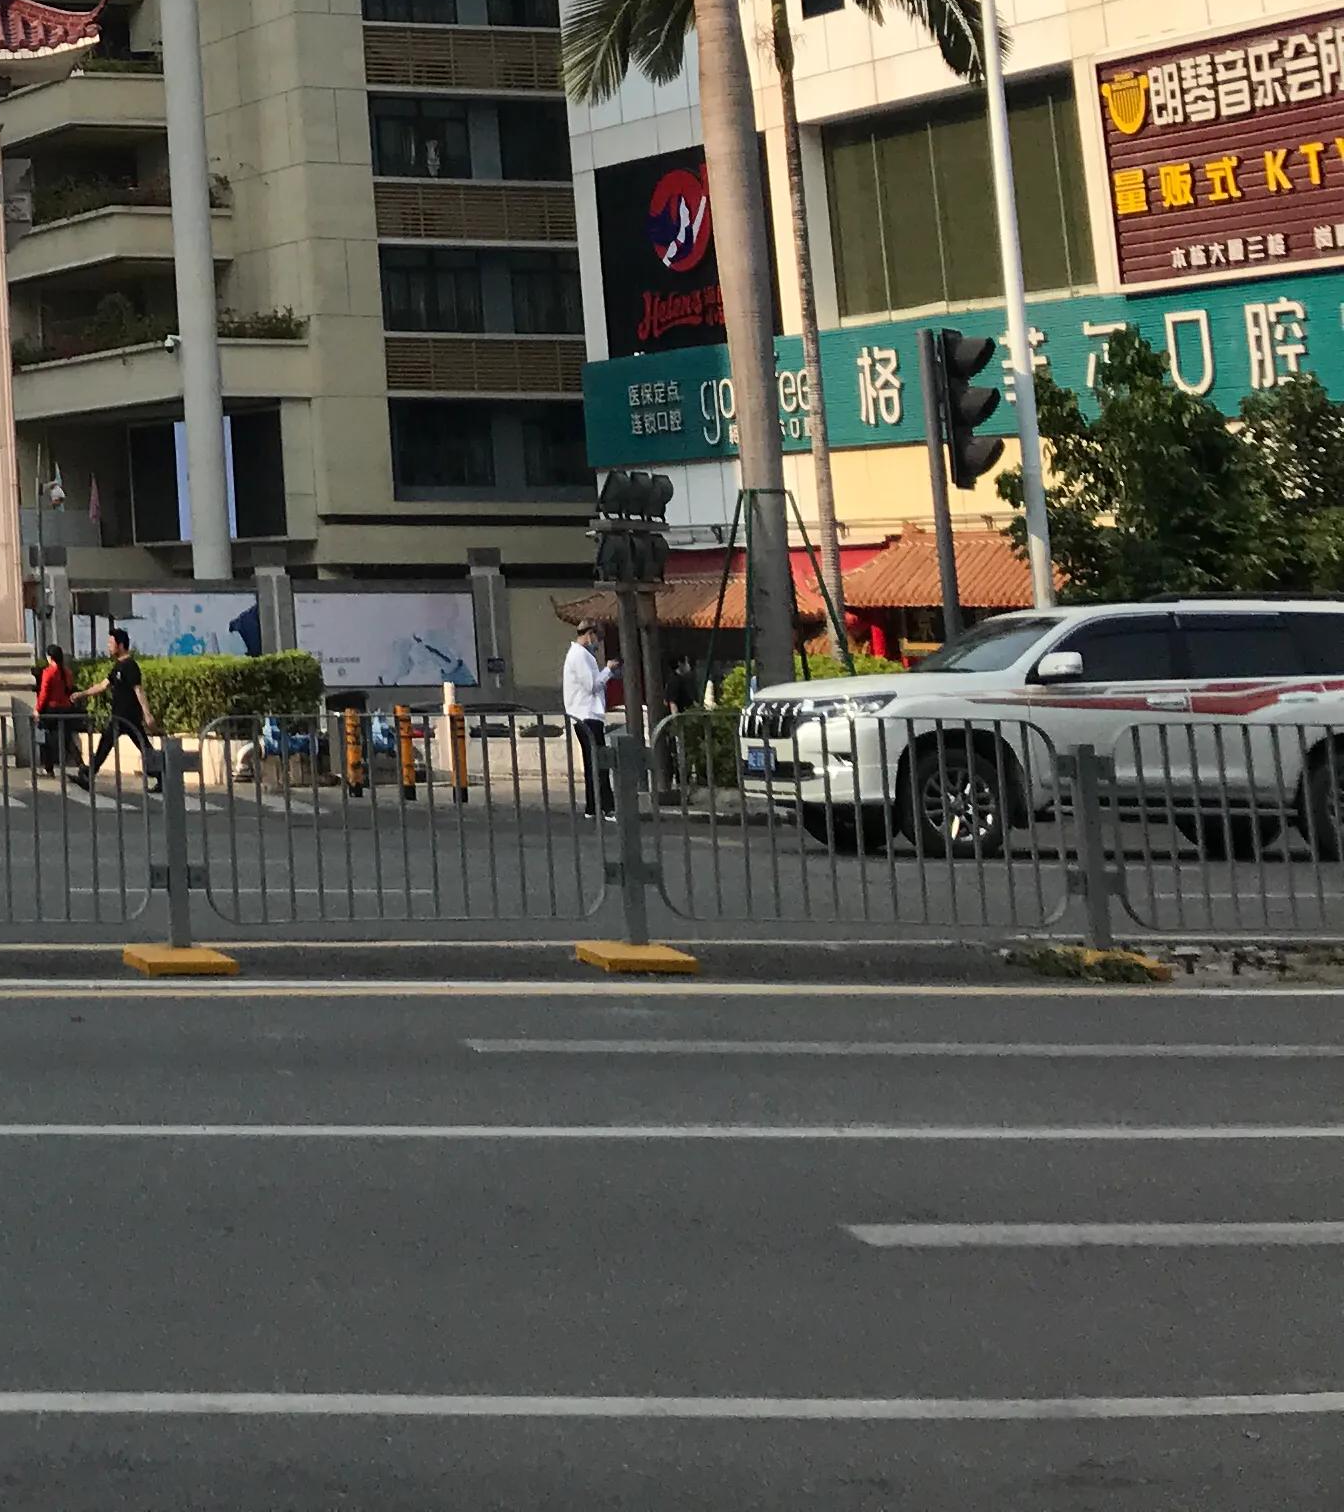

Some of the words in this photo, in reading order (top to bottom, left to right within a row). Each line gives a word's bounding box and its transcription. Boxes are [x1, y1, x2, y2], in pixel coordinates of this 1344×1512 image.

[1114, 155, 1242, 215] 量贩式
[628, 380, 680, 407] 医保定点
[631, 410, 682, 435] 连锁口腔
